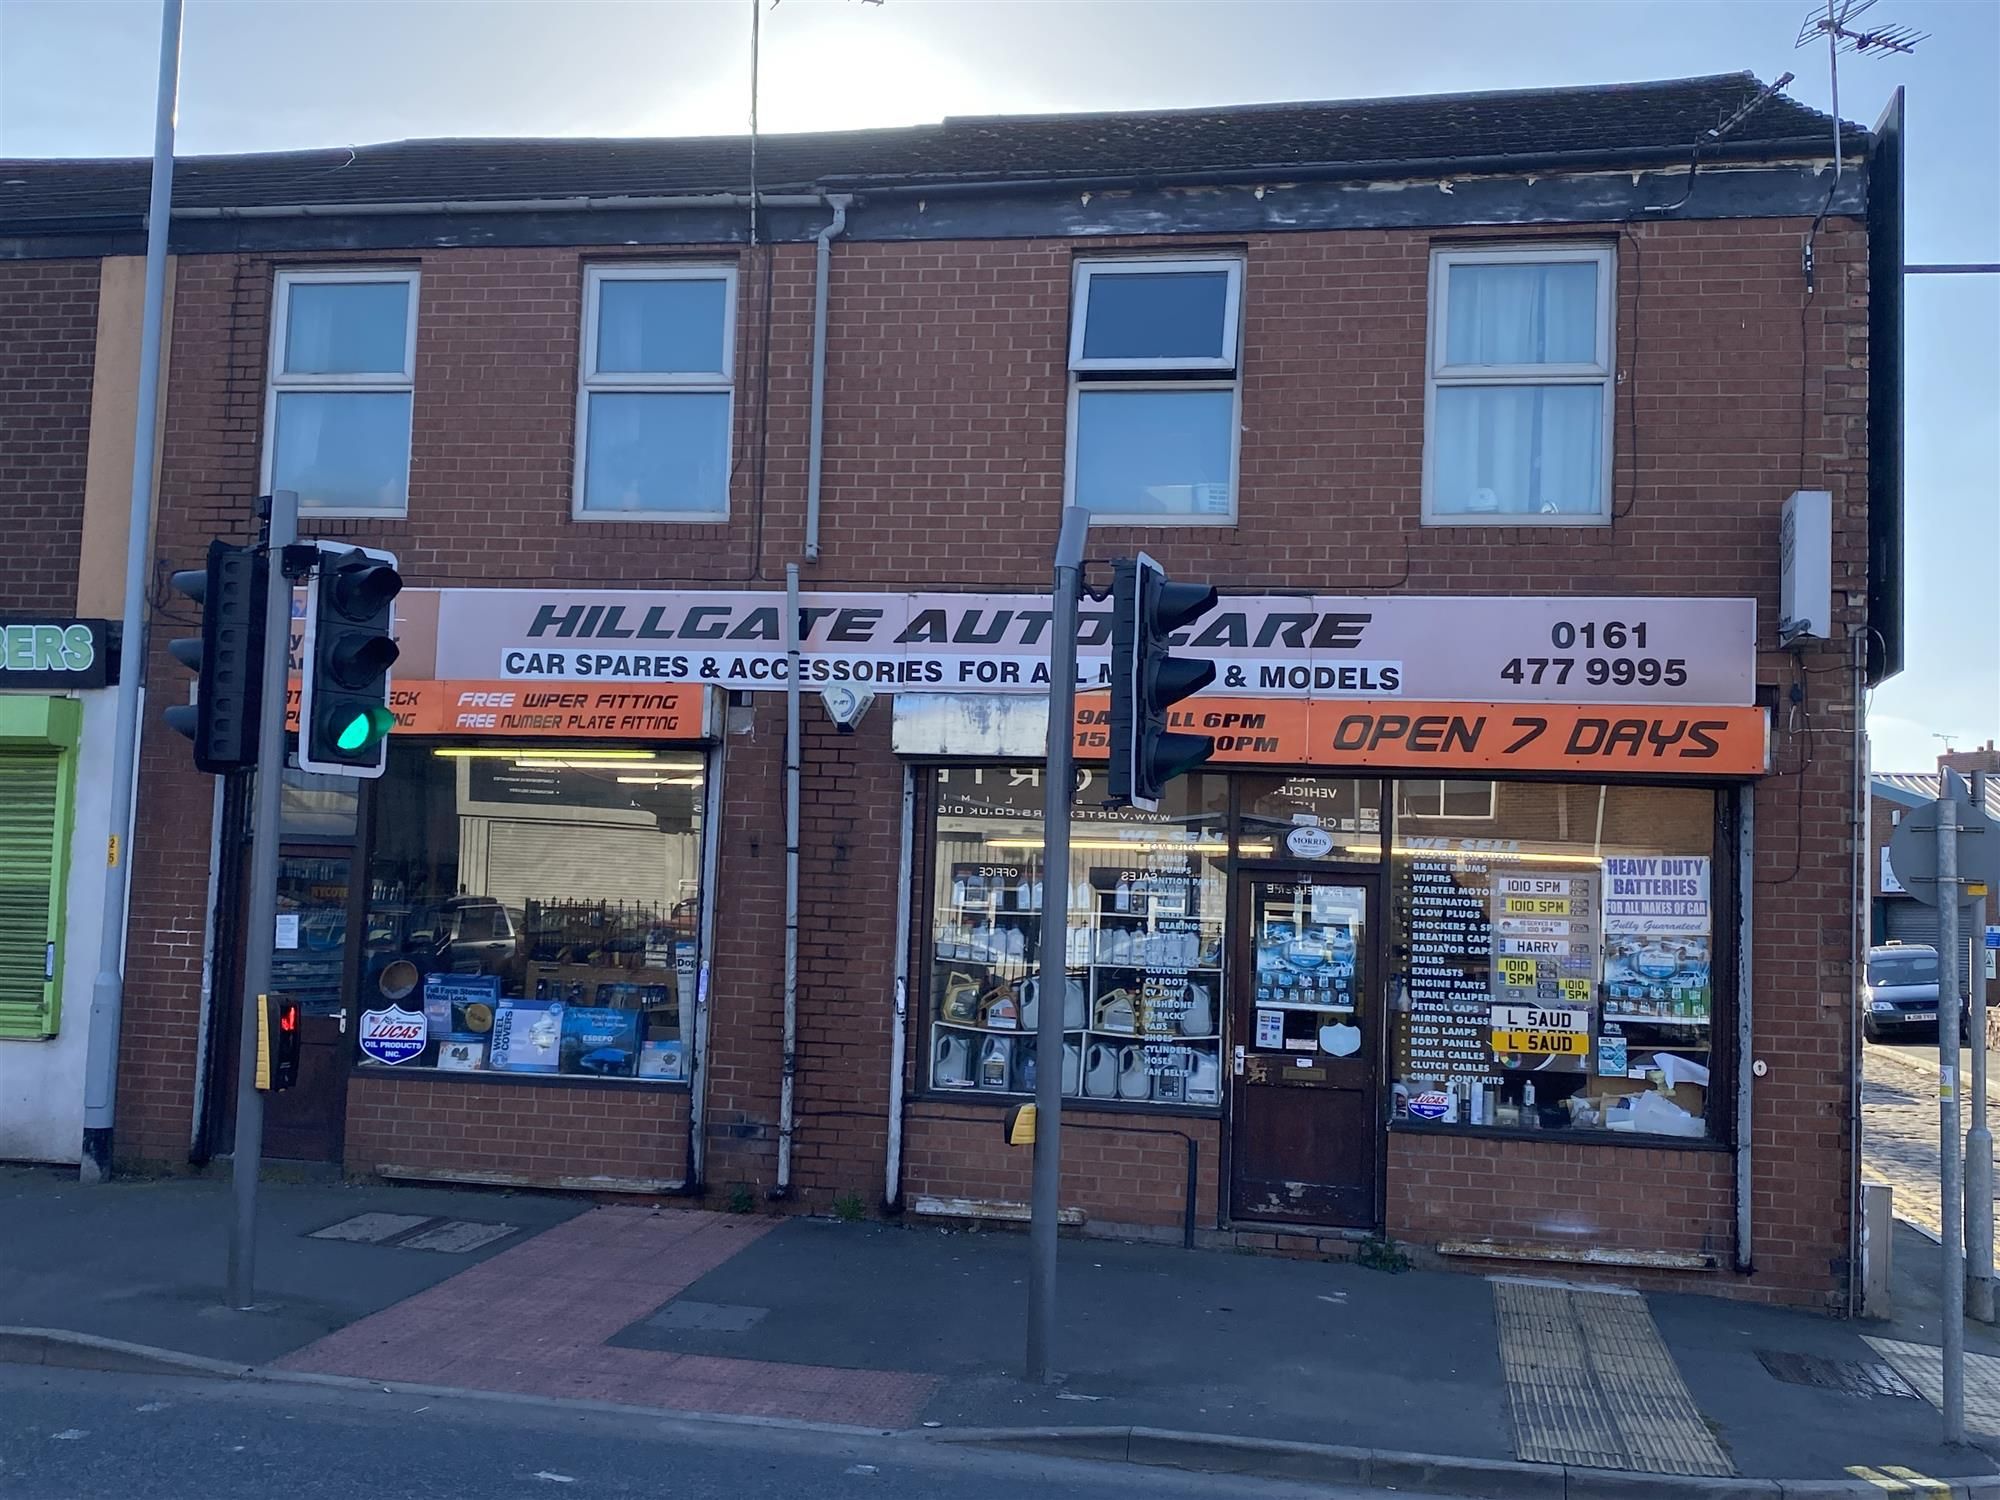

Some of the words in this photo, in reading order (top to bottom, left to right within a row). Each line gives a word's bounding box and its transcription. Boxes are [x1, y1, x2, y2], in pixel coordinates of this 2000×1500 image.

[526, 605, 884, 642] HILLGATE
[1551, 621, 1647, 649] 0161
[0, 624, 94, 671] ERS
[506, 652, 565, 675] CAR
[575, 654, 689, 678] SPARES
[700, 656, 721, 679] &
[728, 657, 943, 683] ACCESSORIES
[959, 660, 1019, 684] FOR
[1031, 662, 1087, 683] AL
[1224, 665, 1247, 687] &
[1259, 666, 1400, 690] MODELS
[1500, 657, 1575, 685] 477
[1586, 658, 1688, 687] 9995
[457, 692, 516, 707] FREE
[522, 693, 587, 709] WIPER
[595, 694, 678, 709] FITTING
[455, 713, 497, 728] FREE
[500, 714, 562, 729] NUMBER
[567, 715, 616, 729] PLATE
[620, 715, 679, 730] FITTING
[1203, 712, 1266, 729] 6PM
[1332, 714, 1487, 752] OPEN
[1501, 717, 1548, 754] 7
[1564, 718, 1728, 758] DAYS
[1293, 836, 1327, 846] MORRIS
[1412, 862, 1447, 871] BRAKE
[1449, 863, 1488, 873] DRUMS
[1607, 858, 1658, 876] HEAVY
[1661, 859, 1704, 876] DUTY
[1412, 873, 1452, 883] WIPERS
[1412, 885, 1455, 895] STARTER
[1536, 881, 1561, 893] SPM
[1613, 878, 1698, 896] BATTERIES
[1412, 896, 1484, 907] ALTERNATORS
[1539, 901, 1564, 913] SPM
[1412, 908, 1443, 917] GLOW
[1446, 909, 1480, 919] PLUGS
[1605, 901, 1624, 914] FOR
[1624, 901, 1639, 914] ALL
[1641, 901, 1673, 915] MAKES
[1674, 902, 1685, 915] OF
[1686, 902, 1706, 915] CAR
[1412, 921, 1466, 931] SHOCKERS
[1469, 922, 1478, 931] &
[1610, 919, 1639, 930] Fully
[1643, 920, 1703, 932] Guaranteed
[1412, 932, 1464, 942] BREATHER
[1467, 934, 1493, 944] CAPS
[1412, 943, 1465, 954] RADIATOR
[1467, 946, 1494, 955] CAPS
[1517, 940, 1559, 953] HARRY
[1411, 955, 1445, 965] BULBS
[1145, 966, 1188, 975] CLUTCHES
[1411, 966, 1464, 977] EXHUASTS
[1145, 977, 1157, 985] CV
[1158, 978, 1189, 986] BOOTS
[1411, 978, 1451, 988] ENGINE
[1453, 980, 1486, 990] PARTS
[1509, 973, 1534, 985] SPM
[1145, 989, 1157, 997] CV
[1411, 990, 1445, 1000] BRAKE
[1448, 992, 1497, 1002] CALIPERS
[1568, 990, 1589, 1000] SPM
[1411, 1003, 1450, 1012] PETROL
[1453, 1004, 1479, 1013] CAPS
[1411, 1014, 1453, 1024] MIRROR
[1507, 1009, 1518, 1025] L
[1527, 1010, 1572, 1028] 5AUD
[369, 1025, 422, 1039] LUCAS
[501, 1010, 513, 1051] COVERS
[1144, 1022, 1168, 1031] PADS
[1411, 1026, 1439, 1035] HEAD
[1442, 1027, 1478, 1037] LAMPS
[493, 1016, 505, 1051] WHEEL
[1144, 1033, 1173, 1042] SHOES
[380, 1041, 422, 1050] PRODUCTS
[1411, 1037, 1440, 1046] BODY
[1442, 1039, 1481, 1049] PANELS
[1508, 1034, 1519, 1050] L
[1528, 1035, 1573, 1052] 5AUD
[1144, 1045, 1192, 1055] CYLINDERS
[1411, 1049, 1445, 1059] BRAKE
[1447, 1051, 1485, 1061] CABLES
[1144, 1056, 1173, 1065] HOSES
[1144, 1068, 1161, 1076] FAN
[1164, 1068, 1189, 1077] BELTS
[1411, 1061, 1449, 1070] CLUTCH
[1452, 1063, 1490, 1073] CABLES
[1410, 1072, 1446, 1082] CHOKE
[1481, 1076, 1505, 1085] KITS
[1414, 1094, 1448, 1104] LUCAS
